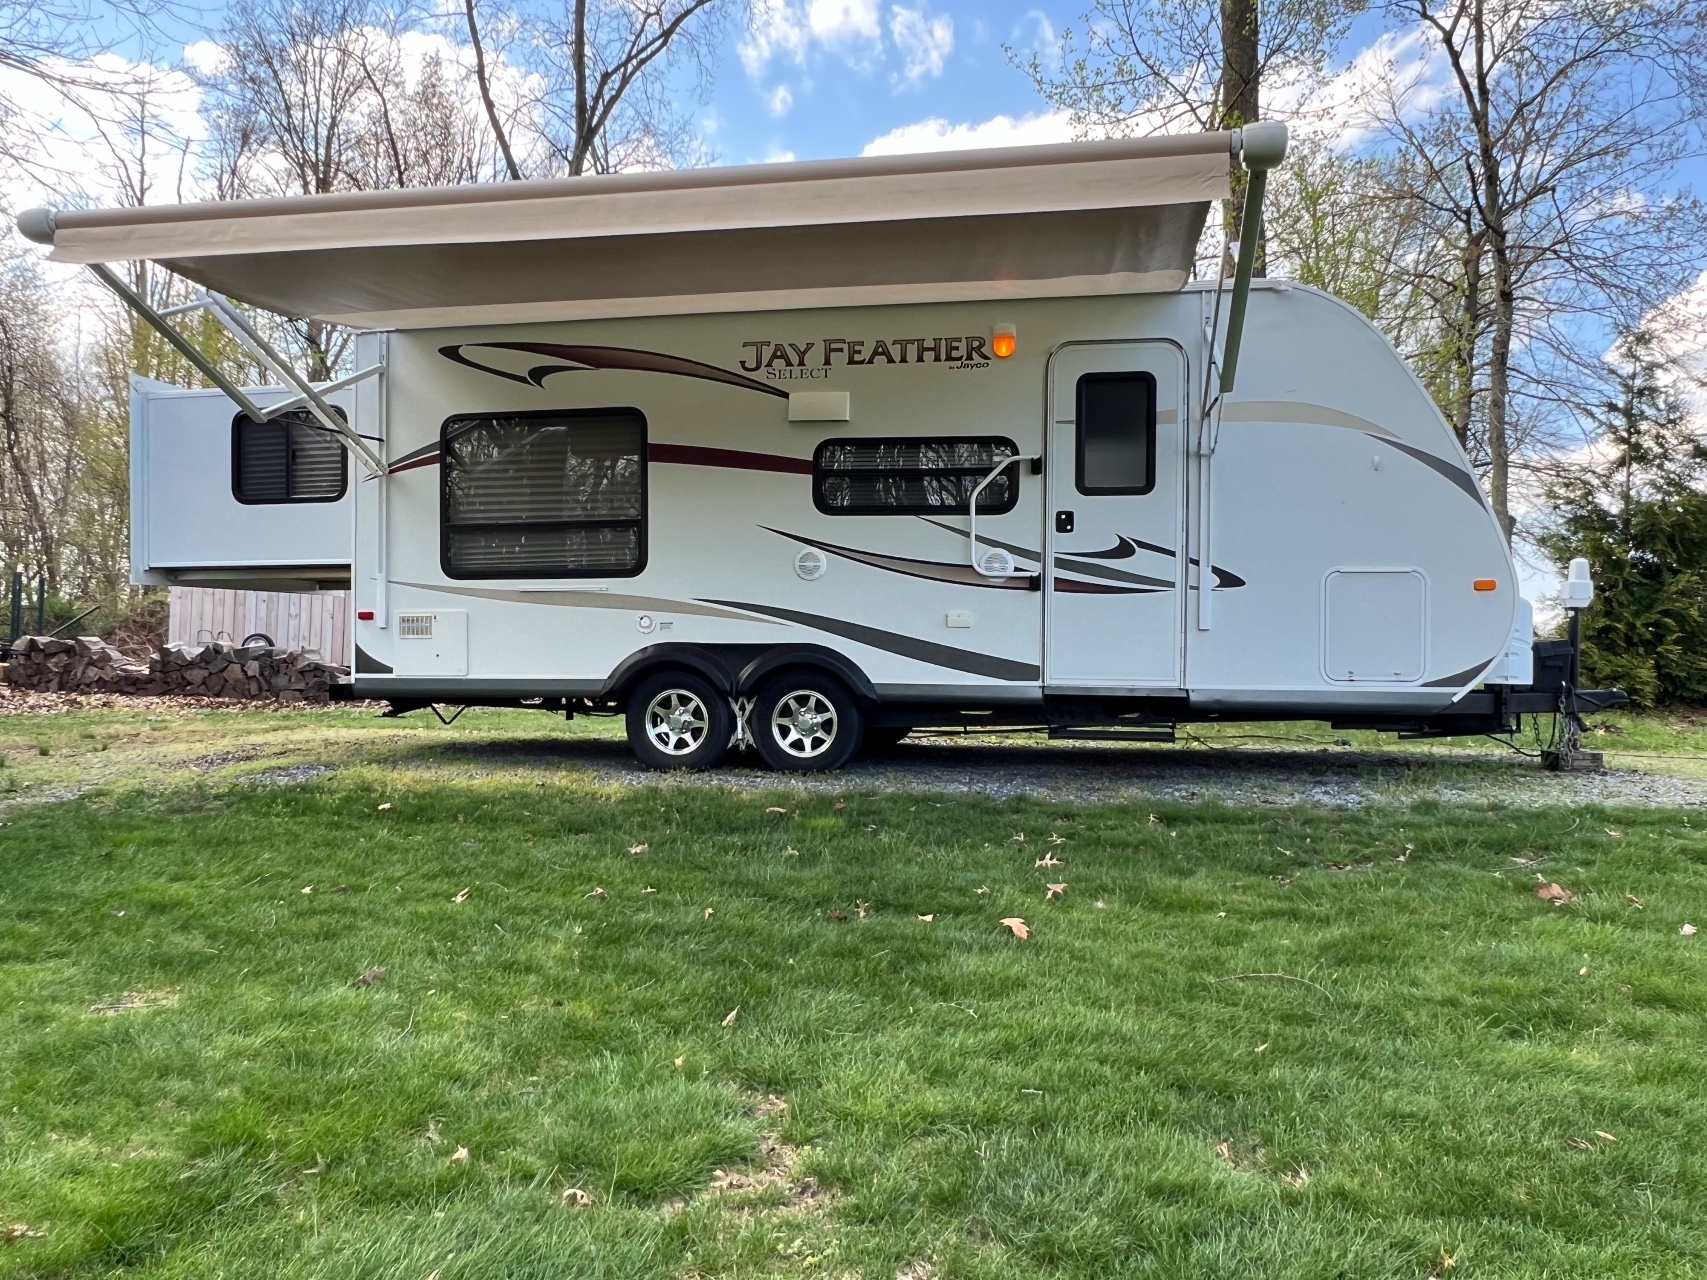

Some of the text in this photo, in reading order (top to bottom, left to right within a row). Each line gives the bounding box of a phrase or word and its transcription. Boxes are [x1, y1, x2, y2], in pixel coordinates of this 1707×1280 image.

[739, 336, 992, 372] JAY FEATHER
[956, 361, 989, 370] Jayco
[766, 368, 831, 380] SELECT
